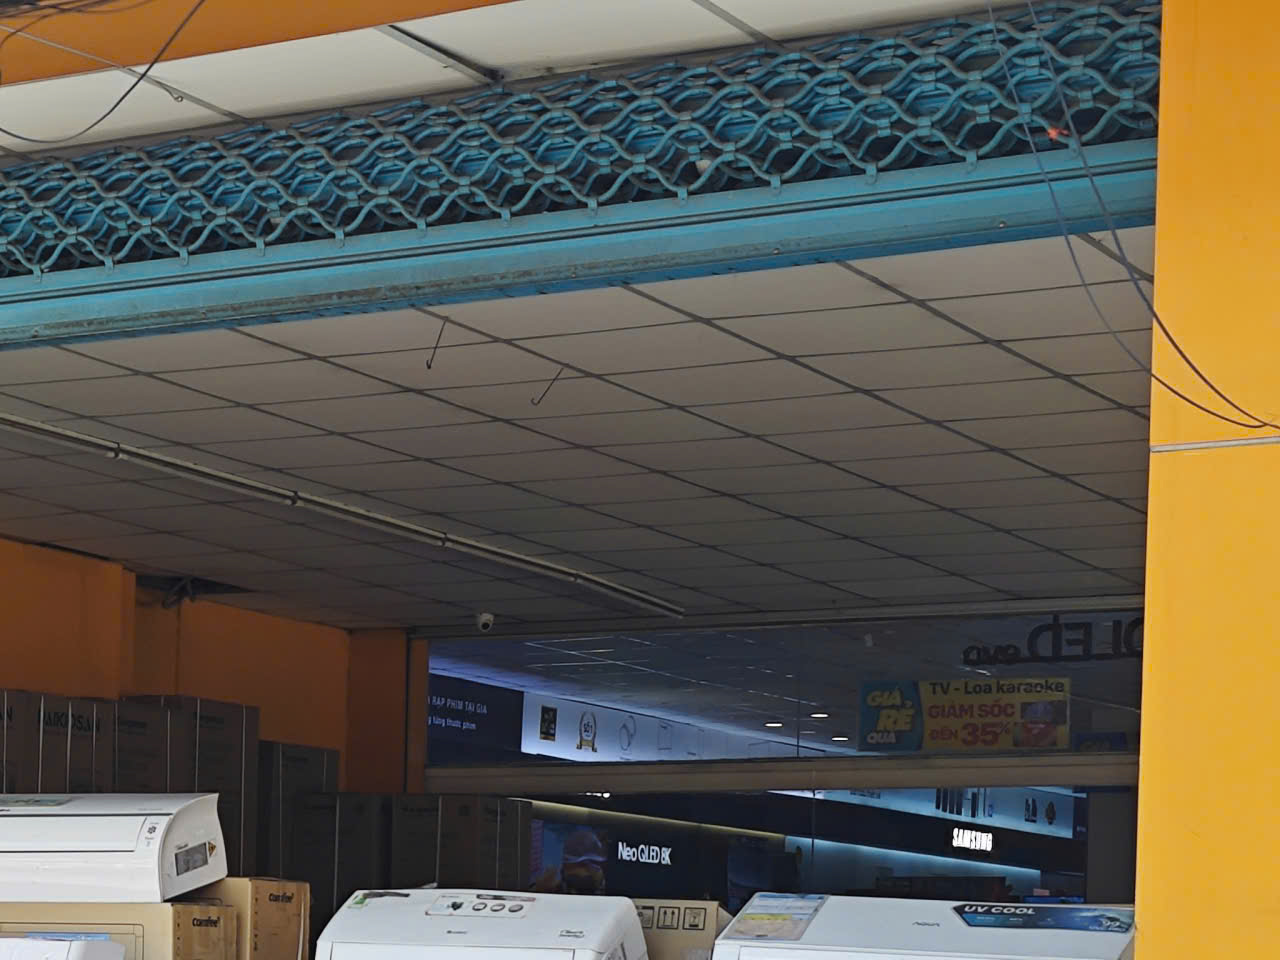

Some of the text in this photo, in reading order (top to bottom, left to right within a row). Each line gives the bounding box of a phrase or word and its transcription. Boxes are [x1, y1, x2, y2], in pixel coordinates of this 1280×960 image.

[929, 680, 1064, 695] TV Loa karaoke
[961, 721, 1011, 747] 35%
[952, 827, 993, 851] SAMSUNG
[618, 841, 672, 865] Neo QLED 8K
[964, 905, 1036, 915] UV COOL
